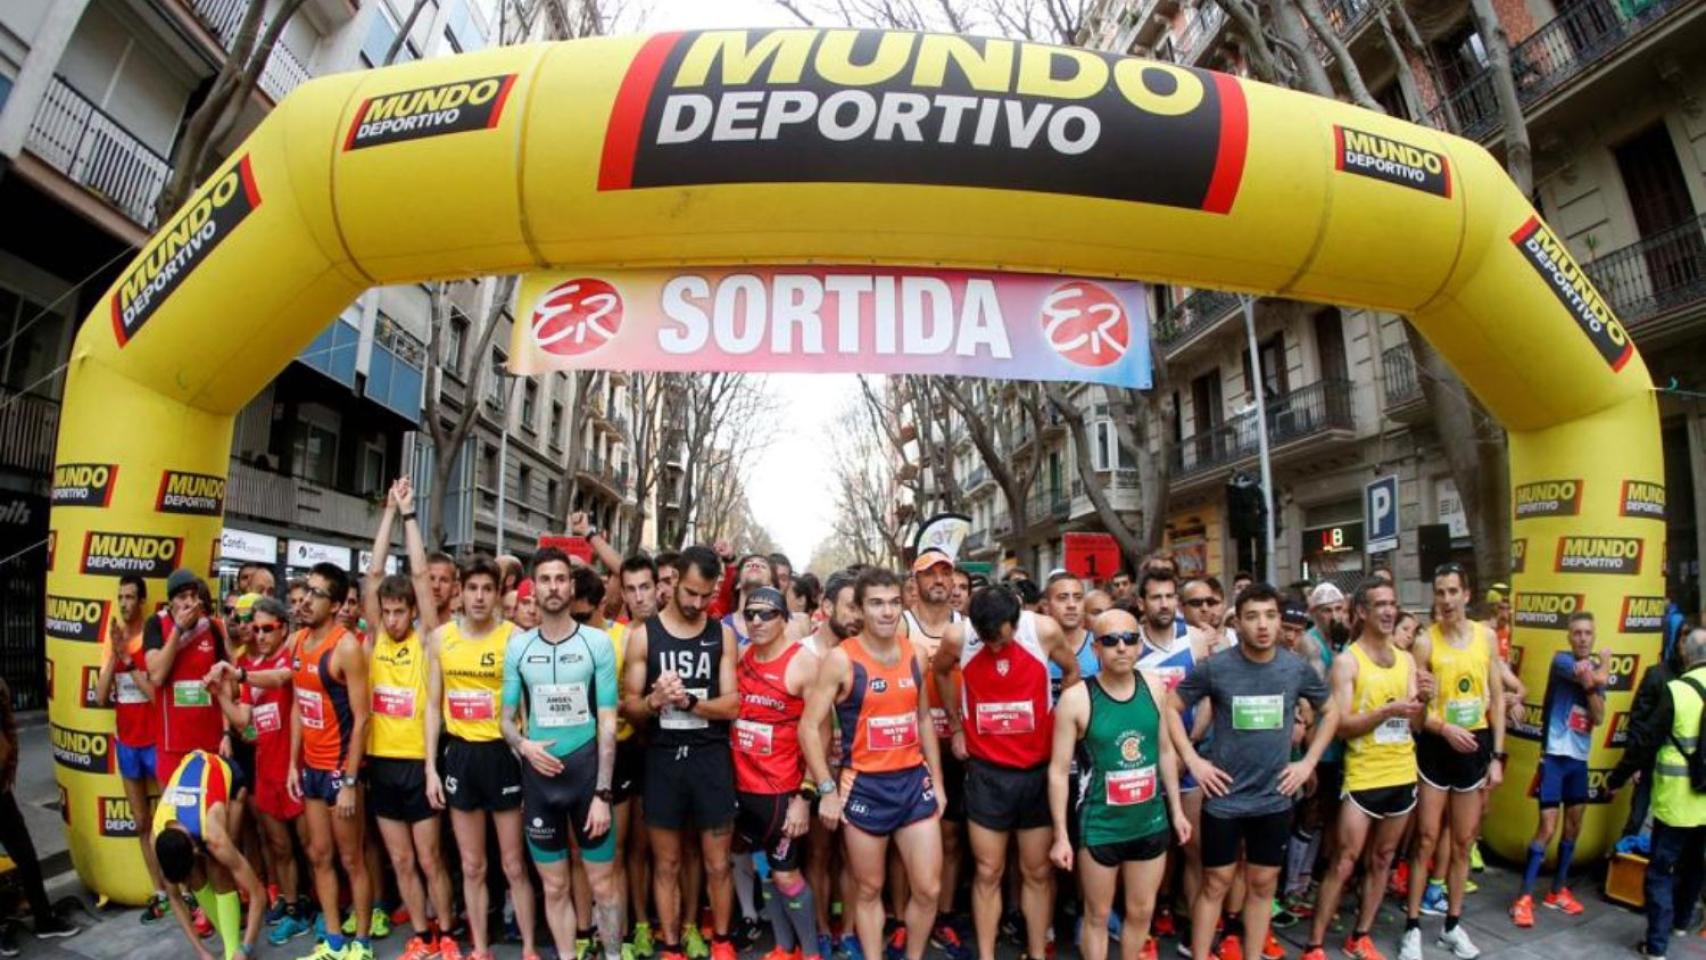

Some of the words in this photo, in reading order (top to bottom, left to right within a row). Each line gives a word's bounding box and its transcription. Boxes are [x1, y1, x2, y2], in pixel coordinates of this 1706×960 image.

[674, 30, 1205, 115] MUNDO
[363, 79, 500, 123] MUNDO
[656, 90, 1101, 155] DEPORTIVO
[356, 108, 460, 139] DEPORTIVO
[1343, 128, 1442, 175] MUNDO
[1345, 152, 1425, 182] DEPORTIVO
[120, 171, 239, 311] MUNDO
[122, 220, 217, 327] DEPORTIVO
[1525, 238, 1602, 333] DEPORTIVO
[1534, 224, 1626, 347] MUNDO
[657, 273, 1012, 360] SORTIDA
[1372, 486, 1391, 535] P
[1627, 483, 1664, 503] MUND
[87, 556, 155, 570] DEPORTIVO
[89, 534, 176, 560] MUNDO
[1085, 554, 1100, 576] 1
[1561, 556, 1623, 568] DEPORTIVO
[1563, 539, 1639, 557] MUNDO
[660, 650, 711, 679] USA
